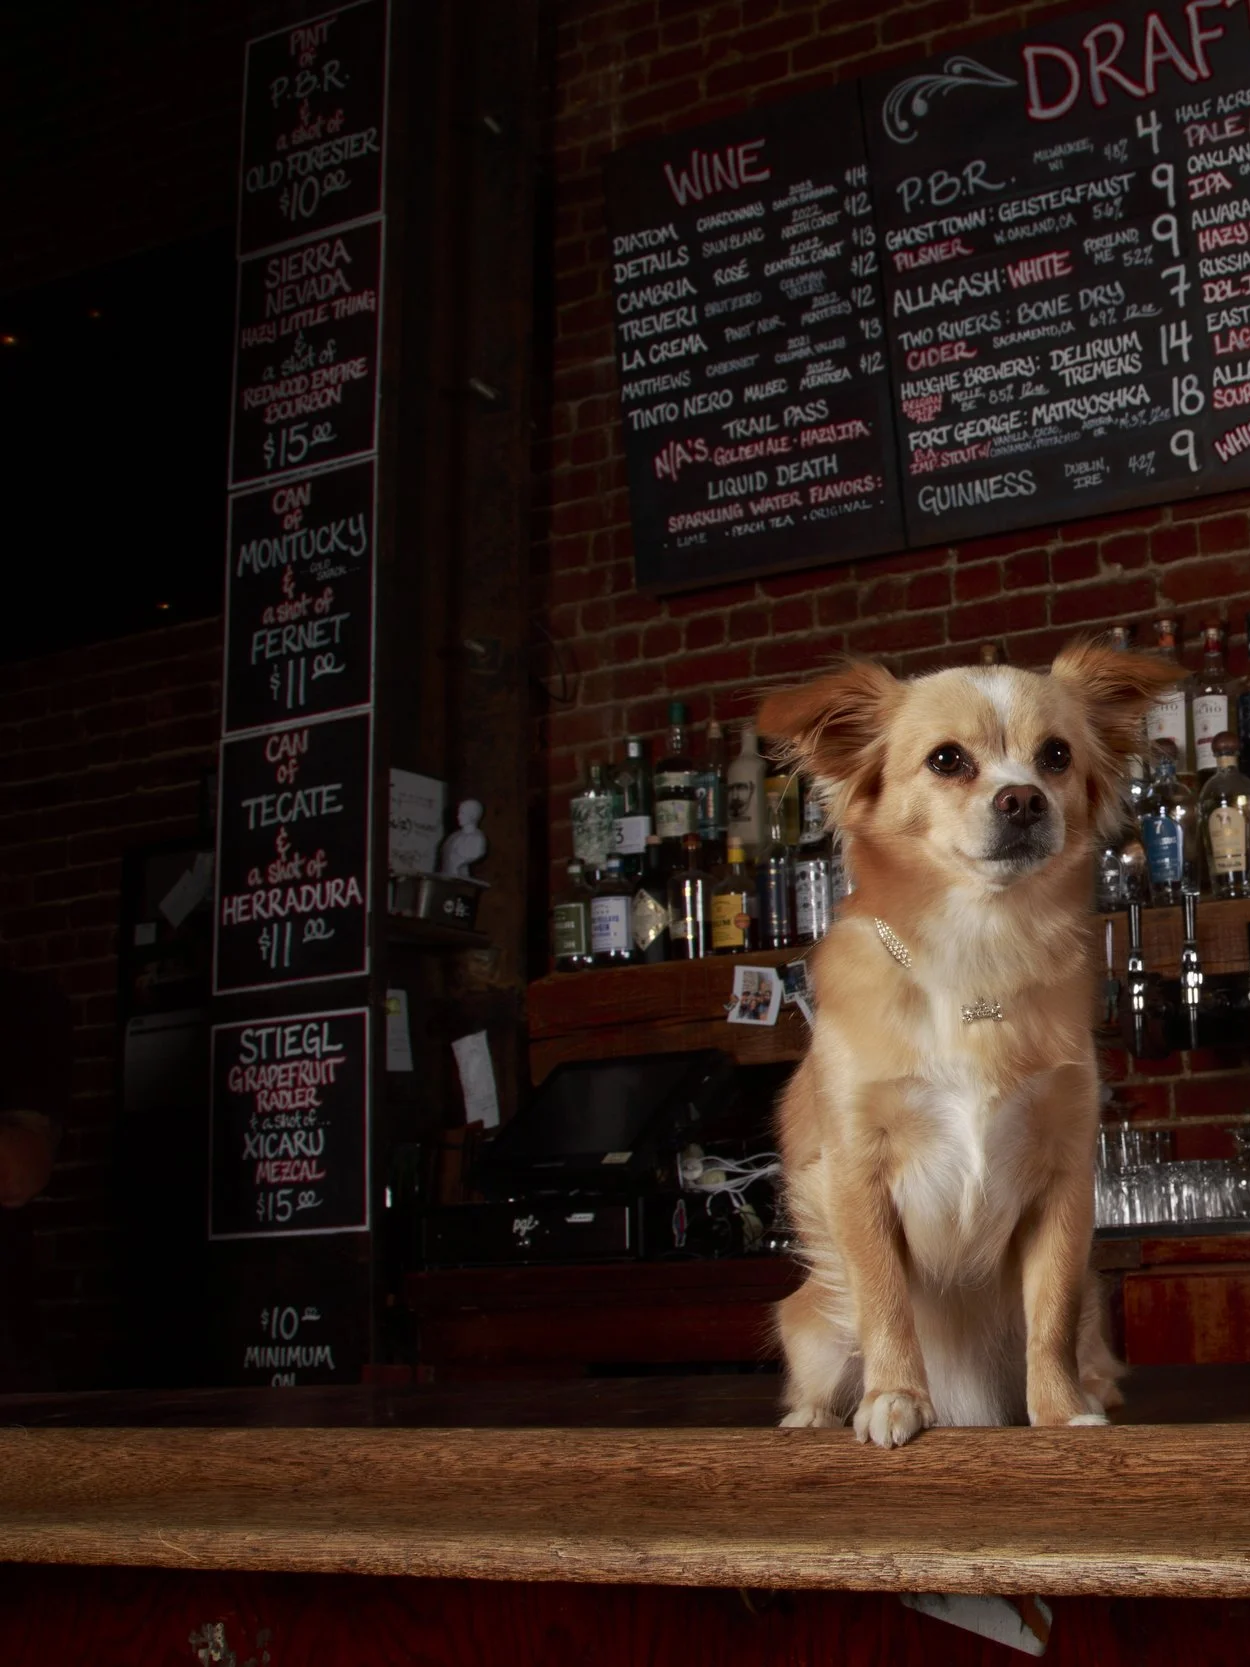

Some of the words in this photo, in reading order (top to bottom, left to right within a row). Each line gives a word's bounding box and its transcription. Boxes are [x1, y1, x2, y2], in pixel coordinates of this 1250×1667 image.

[290, 16, 338, 56] PINT
[291, 115, 326, 146] shot
[1135, 109, 1163, 155] 4
[1175, 102, 1214, 124] HALF
[1183, 114, 1246, 148] PALE
[245, 162, 283, 193] OLD
[286, 127, 381, 180] FORESTER
[664, 138, 771, 207] WINE
[884, 222, 935, 251] GHOST
[998, 171, 1137, 223] GEISTERFAUST
[1150, 161, 1176, 209] 9
[1186, 171, 1233, 201] IPA
[612, 222, 679, 257] DIATOM
[696, 201, 766, 233] CHARDONNAY
[1198, 221, 1248, 253] HAZY
[264, 238, 353, 289] SIERRA
[612, 245, 690, 284] DETAILS
[892, 237, 974, 273] PILSNER
[1007, 250, 1074, 291] WHITE
[1151, 213, 1181, 259] 9
[264, 268, 352, 318] NEVADA
[616, 277, 698, 315] CAMBRIA
[712, 258, 750, 287] ROSÉ
[1017, 294, 1073, 326] BONE
[1079, 280, 1126, 310] DRY
[1161, 263, 1192, 308] 7
[241, 320, 276, 349] HAZY
[279, 304, 330, 336] LITTLE
[331, 289, 376, 320] THING
[618, 305, 698, 343] TREVERI
[898, 326, 934, 351] TWO
[280, 346, 316, 377] shot
[319, 338, 337, 364] of
[621, 349, 647, 372] LA
[649, 333, 709, 365] CREMA
[900, 371, 962, 401] HUYGHE
[1049, 331, 1144, 372] DELIRIUM
[1160, 319, 1194, 366] 14
[906, 340, 979, 372] CIDER
[1058, 353, 1143, 388] TREMENS
[243, 375, 309, 411] REDWOOD
[310, 356, 369, 390] EMPIRE
[621, 370, 692, 403] MATTHEWS
[263, 384, 342, 425] BOURBON
[628, 403, 679, 431] TINTO
[683, 389, 734, 419] NERO
[743, 378, 789, 404] MALBEC
[722, 419, 779, 440] TRAIL
[783, 399, 830, 427] PASS
[908, 423, 952, 452] FORT
[1031, 383, 1151, 427] MATRYOSHKA
[1171, 374, 1206, 417] 18
[713, 442, 764, 468] GOLDEN
[917, 468, 1038, 517] GUINNESS
[1168, 429, 1199, 473] 9
[272, 482, 313, 514] CAN
[707, 471, 769, 503] LIQUID
[776, 453, 840, 487] DEATH
[667, 503, 745, 535] SPARKLING
[748, 491, 804, 517] WATER
[807, 475, 885, 506] FLAVORS:
[236, 512, 369, 579] MONTUCKY
[275, 593, 313, 622] shot
[314, 585, 336, 614] of
[250, 611, 352, 666] FERNET
[265, 728, 310, 762] CAN
[276, 757, 299, 784] of
[240, 783, 344, 831] TECATE
[267, 852, 305, 885] shot
[306, 848, 328, 878] of
[222, 876, 364, 927] HERRADURA
[239, 1021, 344, 1065] STIEGL
[228, 1056, 346, 1095] GRAPEFRUIT
[256, 1087, 323, 1114] RADLER
[242, 1128, 325, 1160] XICARU
[255, 1160, 326, 1185] MEZCAL
[243, 1344, 336, 1371] MINIMUM
